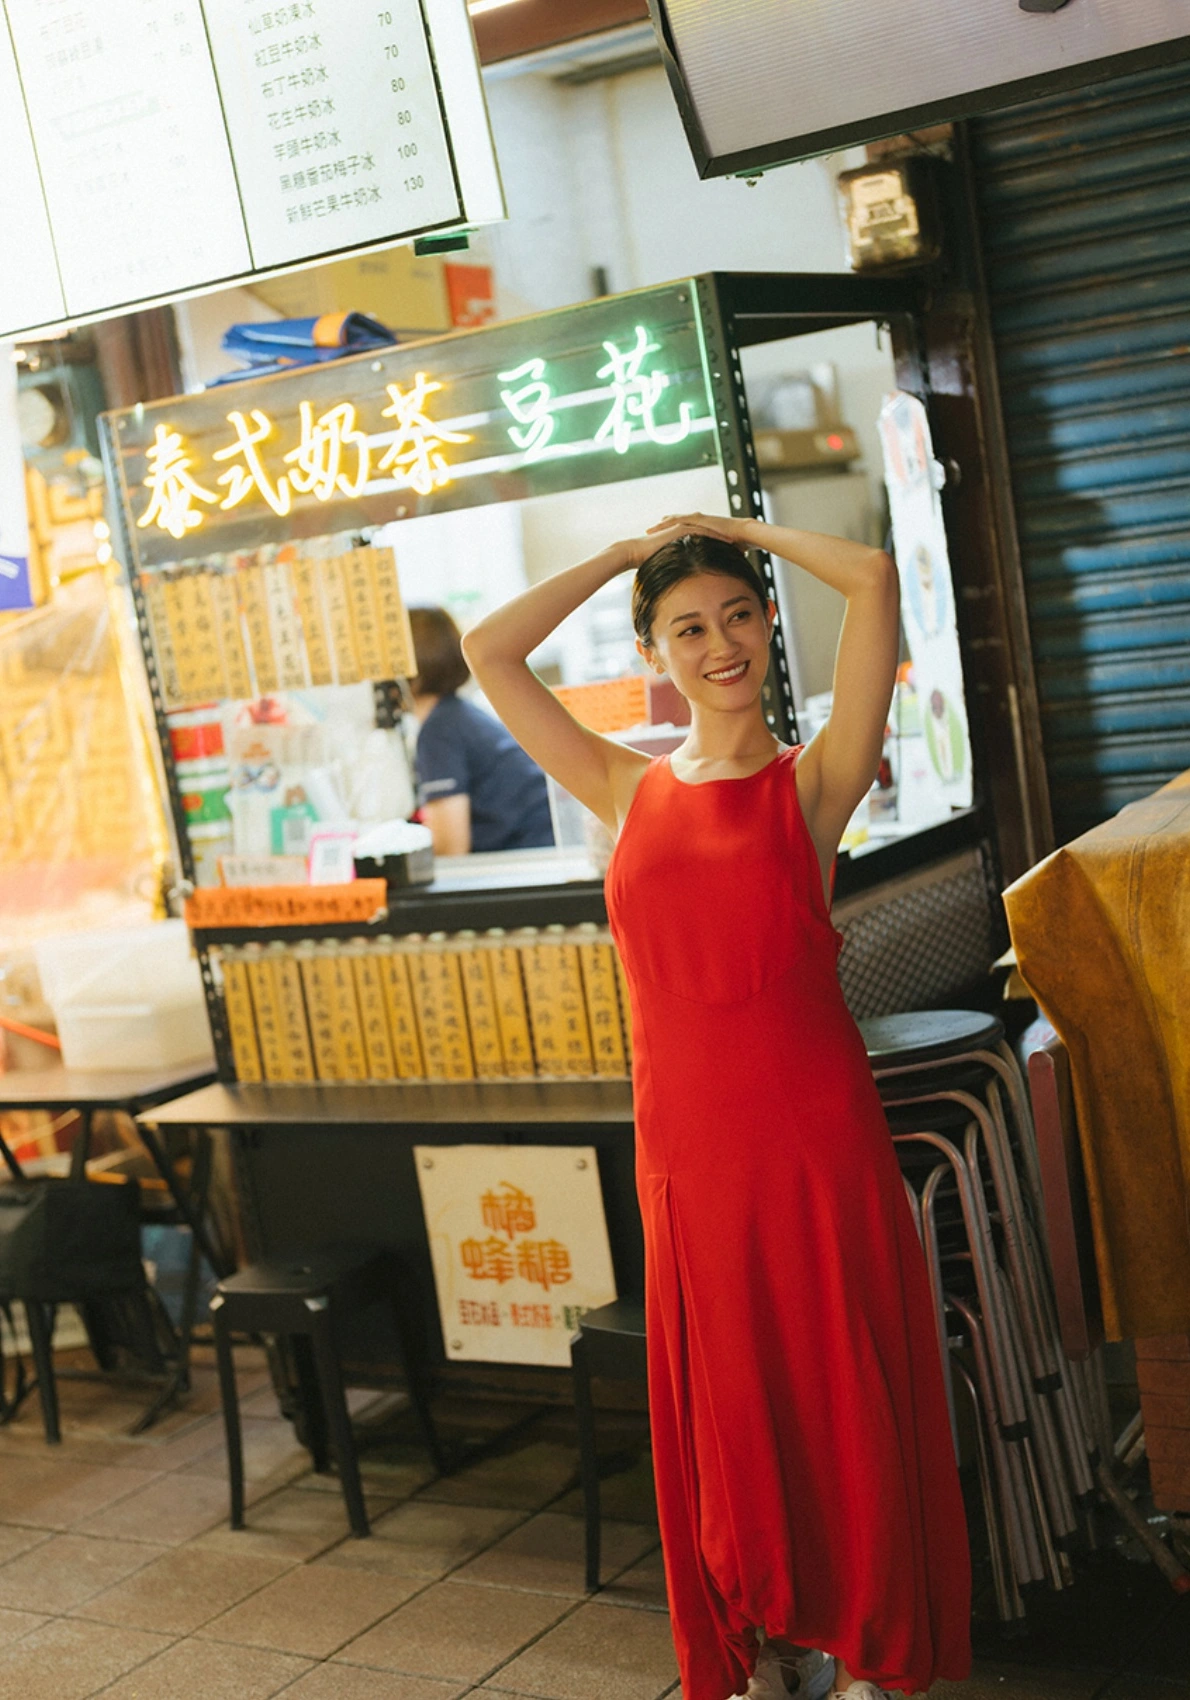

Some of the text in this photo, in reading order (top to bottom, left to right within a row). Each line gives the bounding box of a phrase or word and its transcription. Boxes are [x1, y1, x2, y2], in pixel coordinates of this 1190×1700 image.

[254, 11, 393, 67] 紅豆牛奶冰 70
[261, 44, 399, 98] 布丁牛奶冰 70
[267, 77, 406, 130] 花生牛奶冰 80
[273, 110, 412, 161] 芋頭牛奶冰 80
[398, 142, 418, 159] 100
[286, 175, 424, 223] 新鮮芒果牛奶冰 130
[137, 326, 695, 538] 泰式奶茶 豆花
[460, 1236, 573, 1292] 蜂糖
